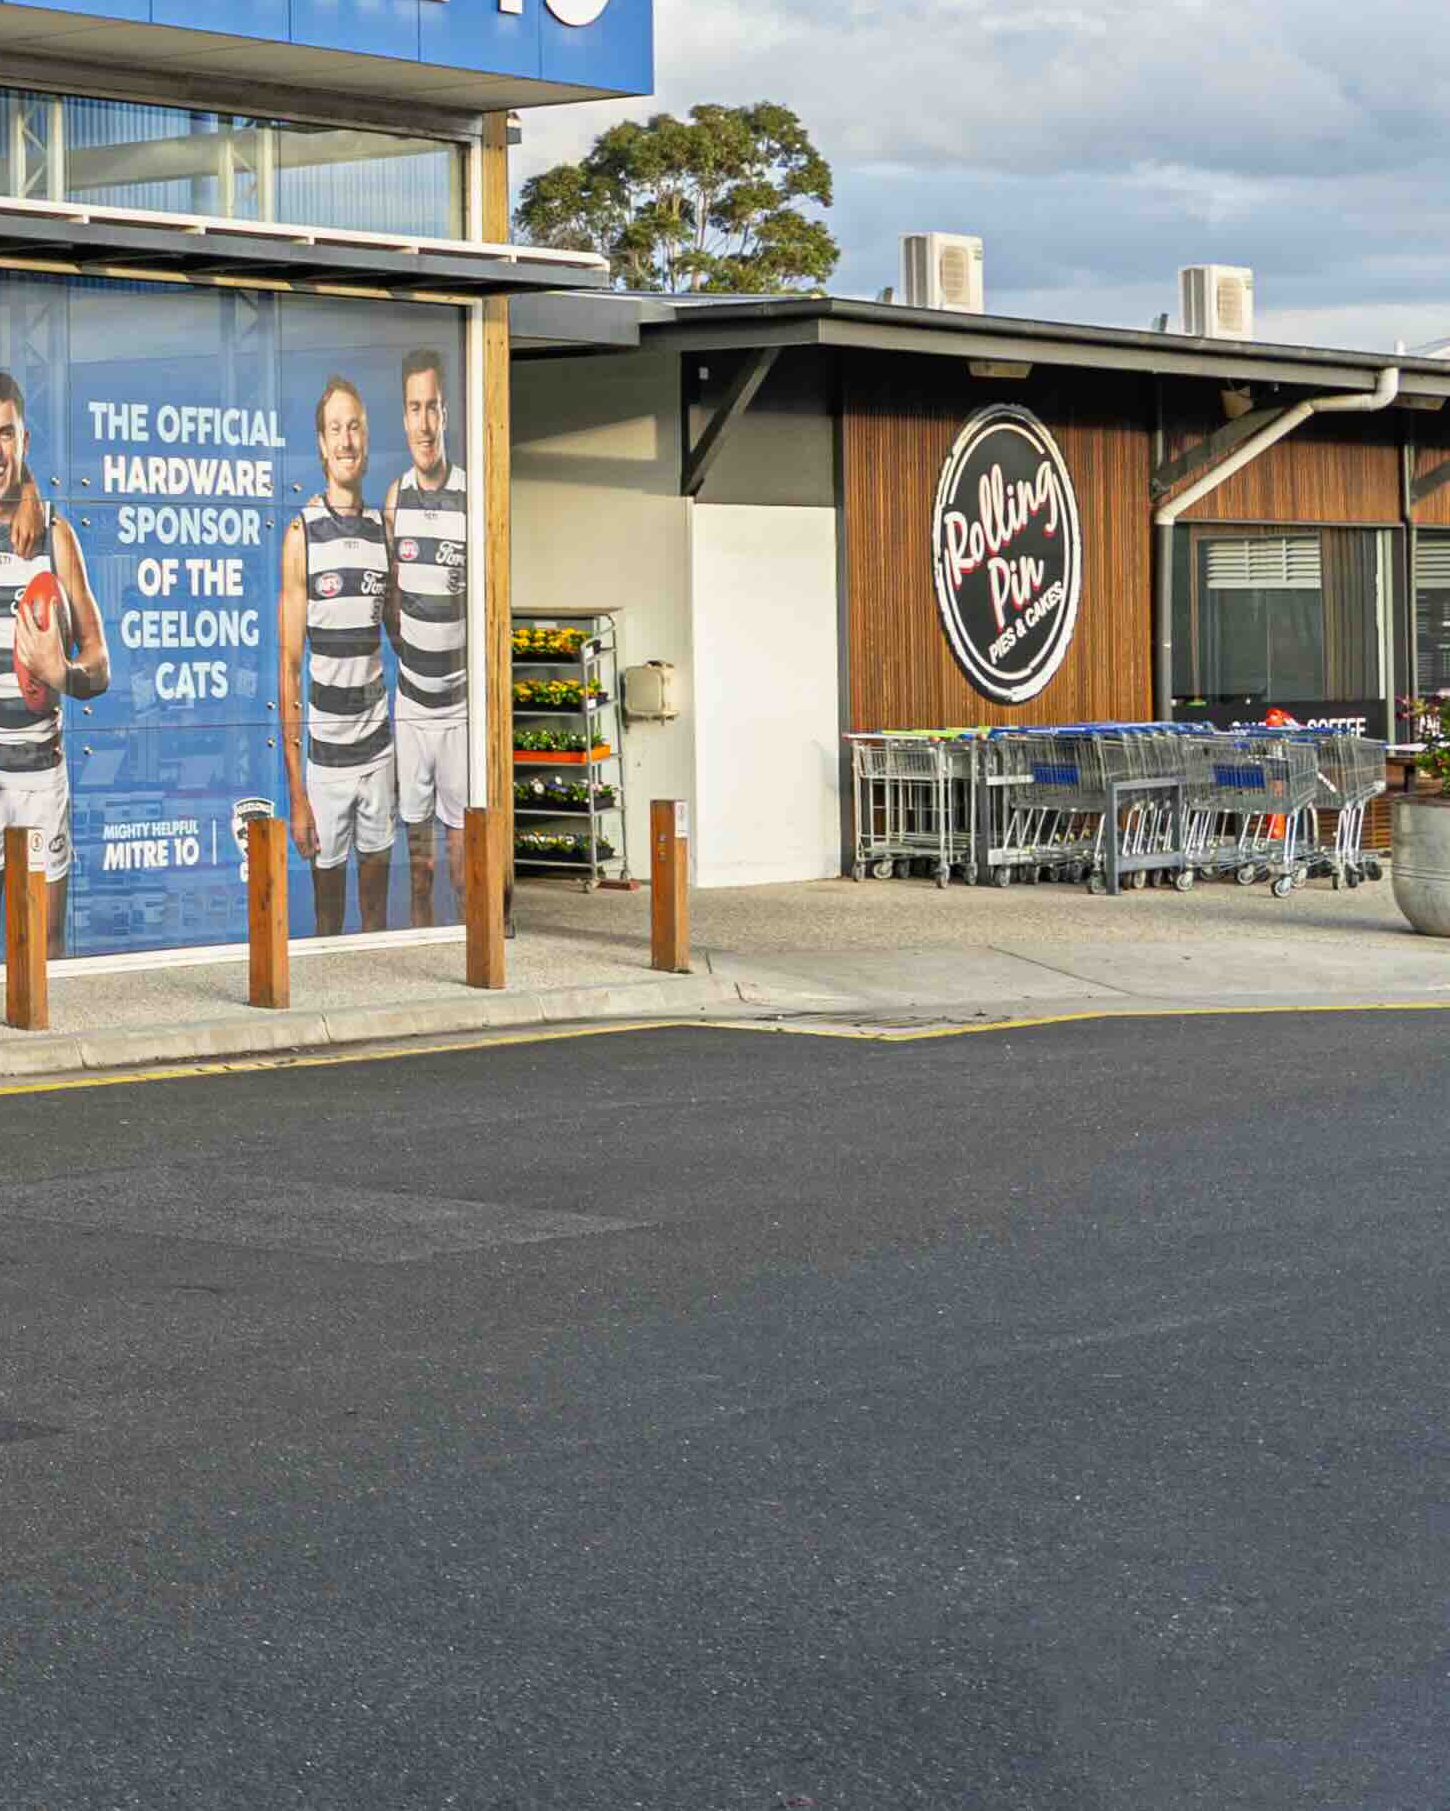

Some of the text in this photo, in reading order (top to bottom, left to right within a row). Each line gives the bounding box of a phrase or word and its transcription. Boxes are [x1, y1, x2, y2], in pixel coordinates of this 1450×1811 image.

[89, 401, 286, 447] THE OFFICIAL
[103, 455, 274, 498] HARDWARE
[117, 506, 261, 545] SPONSOR
[944, 461, 1059, 590] Rolling
[137, 558, 244, 597] OF THE
[987, 556, 1045, 634] Pin
[121, 610, 259, 648] GEELONG
[988, 579, 1065, 665] PIES & CAKES
[155, 661, 228, 699] CATS
[103, 819, 199, 840] MIGHTY HELPFUL
[103, 838, 200, 871] MITRE 10
